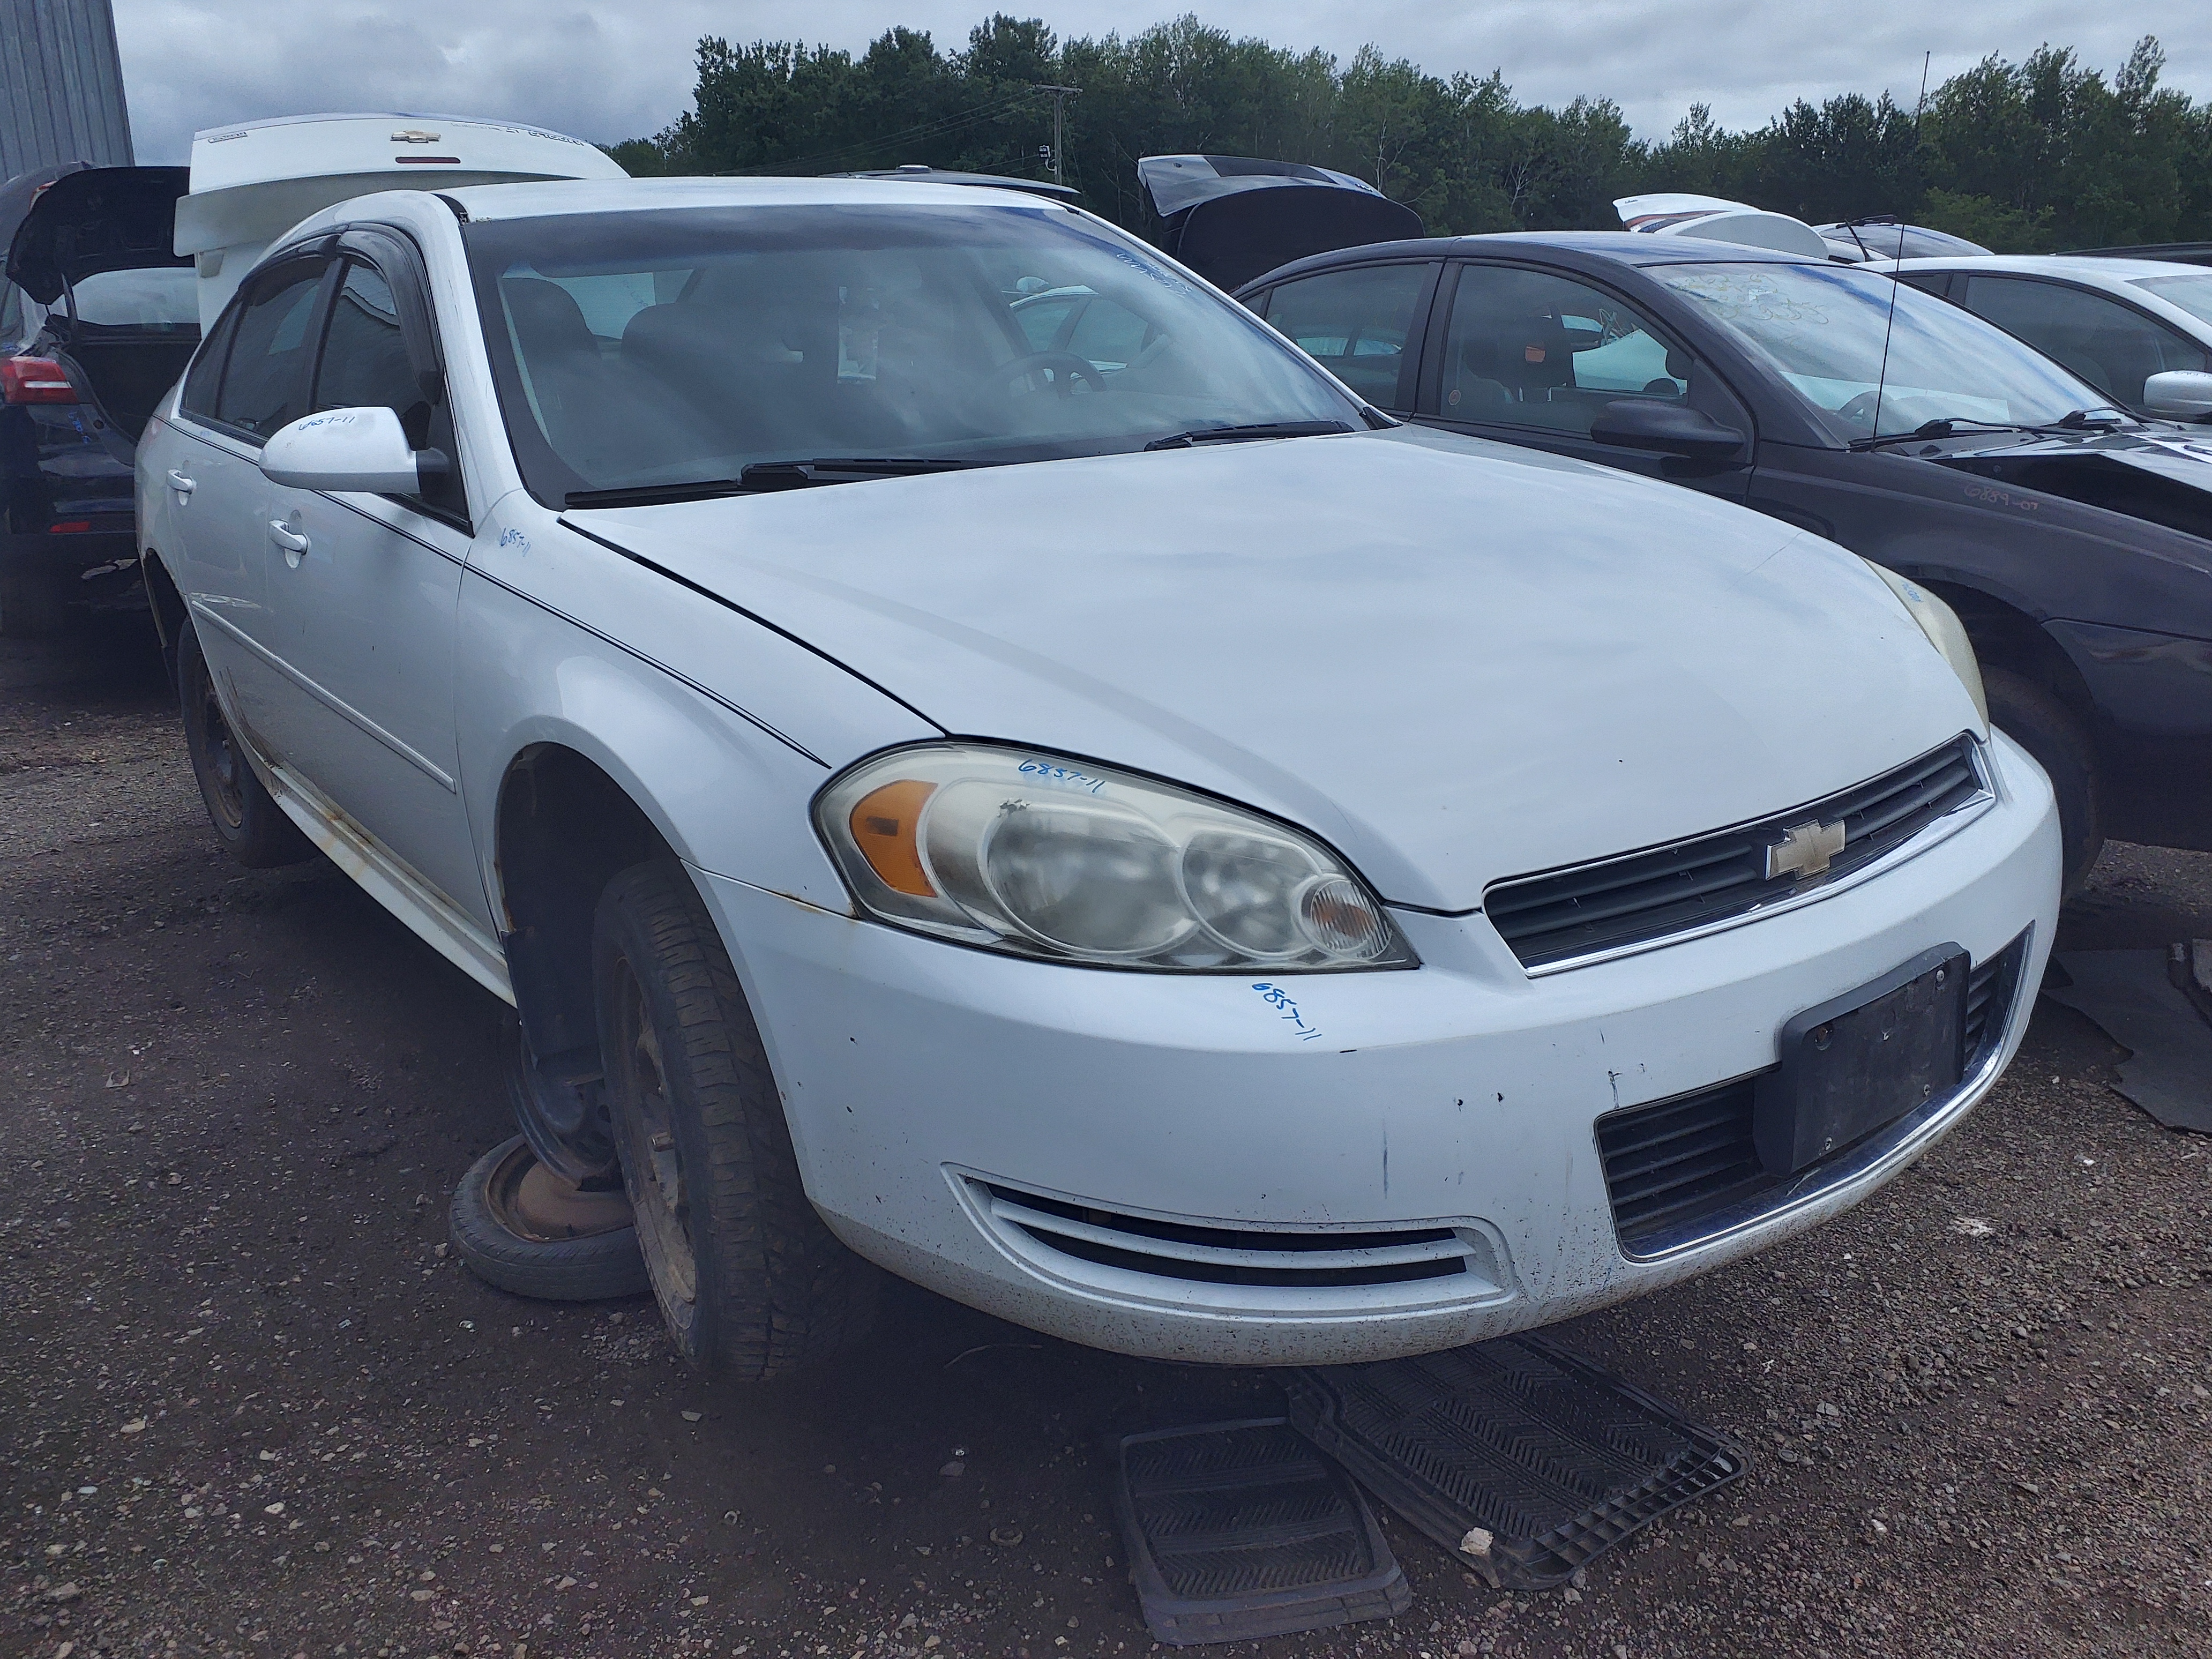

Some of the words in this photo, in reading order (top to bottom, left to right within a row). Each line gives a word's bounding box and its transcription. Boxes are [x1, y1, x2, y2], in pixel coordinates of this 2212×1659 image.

[298, 416, 356, 431] 6857-11
[499, 527, 532, 557] 6857-11
[1018, 758, 1105, 794] 6857-11
[1251, 982, 1322, 1041] 6857-11
